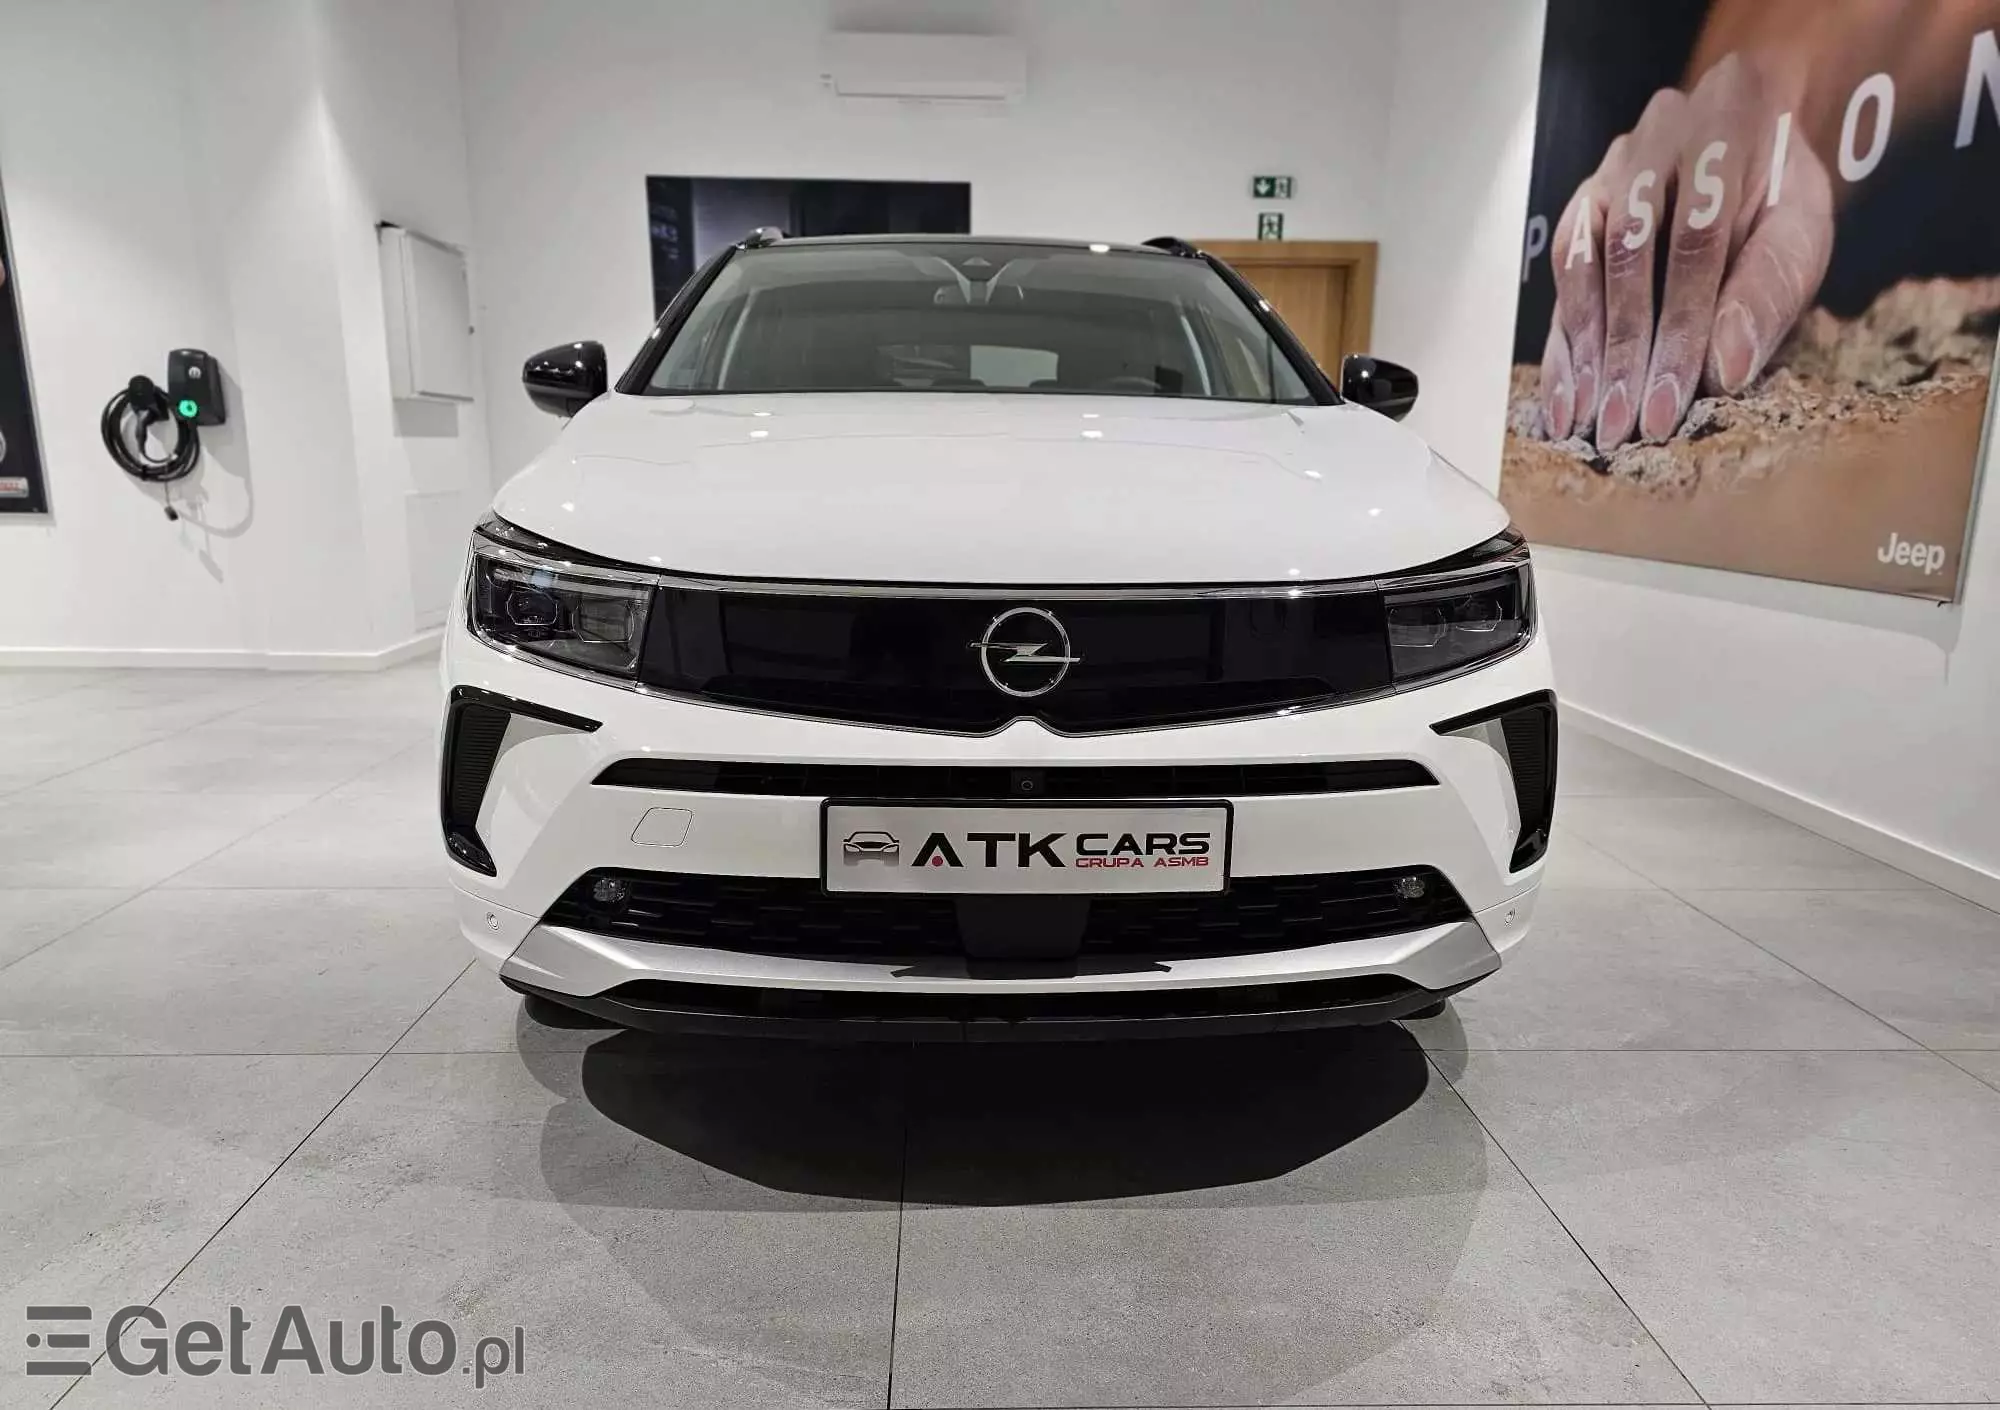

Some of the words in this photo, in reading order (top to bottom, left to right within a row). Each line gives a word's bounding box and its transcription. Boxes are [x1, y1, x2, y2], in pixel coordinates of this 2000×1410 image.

[1877, 532, 1946, 576] Jeep
[911, 832, 1067, 868] ATK
[1075, 832, 1211, 856] CARS
[1075, 857, 1146, 868] GRUPA
[1153, 856, 1210, 867] ASMB
